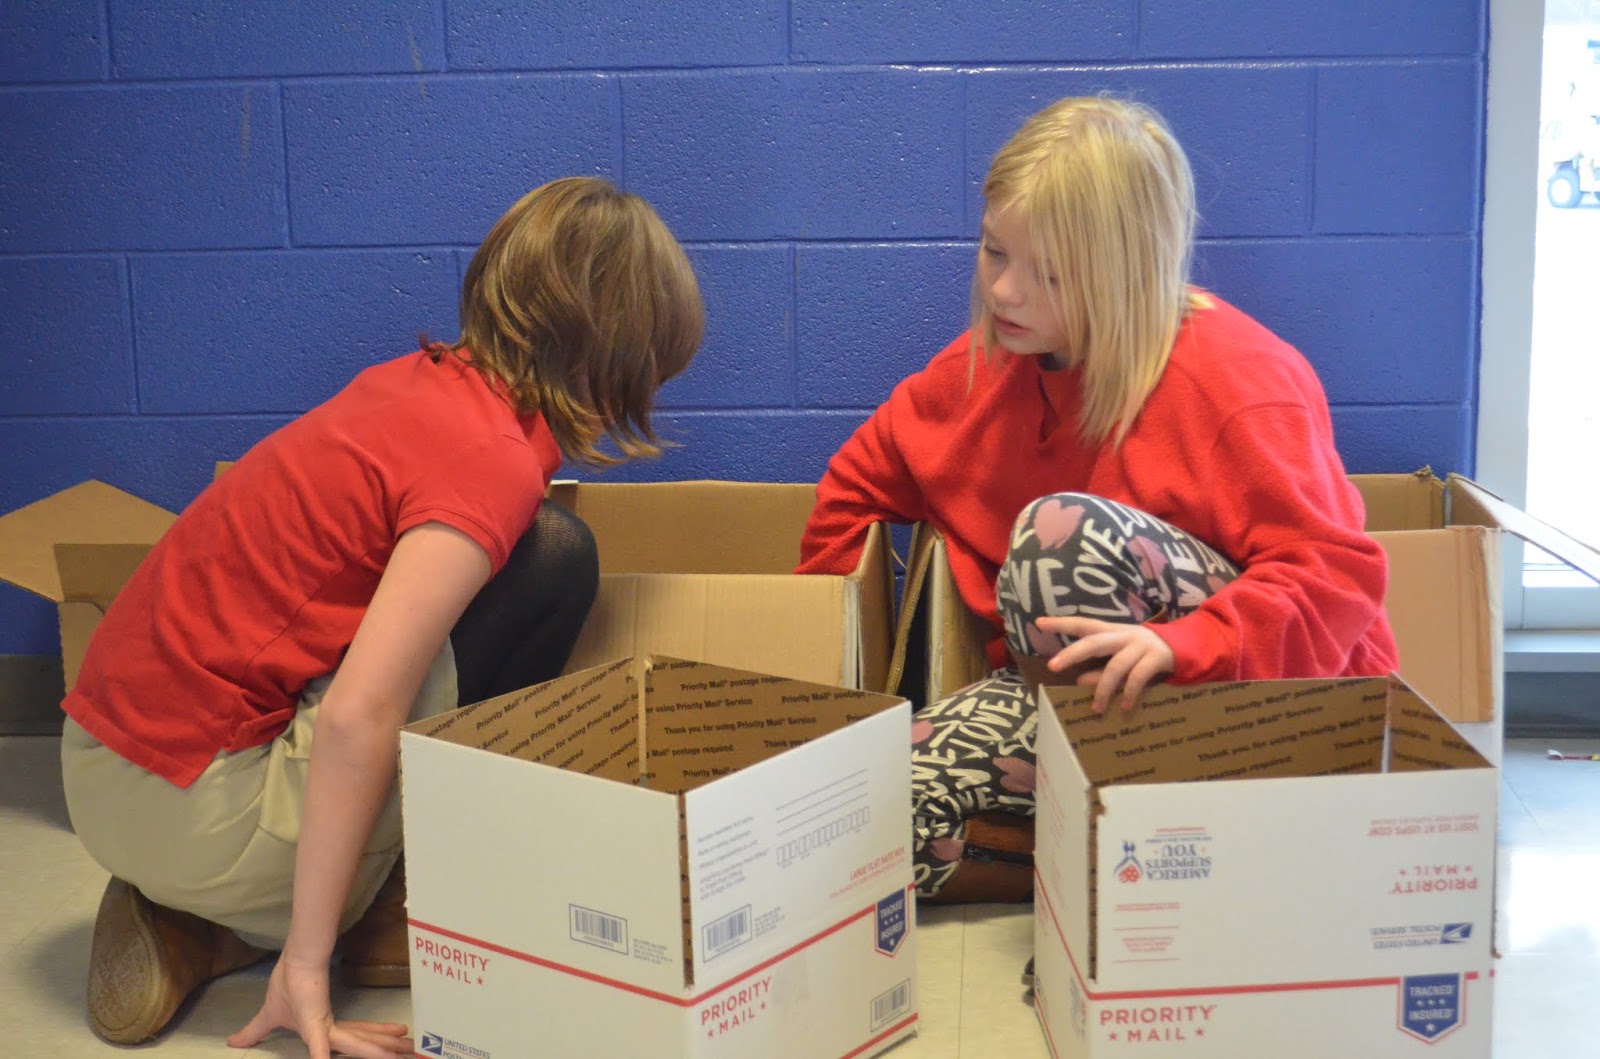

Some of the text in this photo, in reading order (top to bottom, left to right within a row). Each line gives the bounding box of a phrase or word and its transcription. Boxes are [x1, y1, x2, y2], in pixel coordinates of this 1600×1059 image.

[1073, 517, 1132, 617] LOVE
[680, 682, 708, 692] Priority
[534, 700, 560, 718] Priority
[676, 701, 703, 711] Priority
[725, 698, 753, 706] Service
[476, 710, 503, 730] Priority
[530, 722, 556, 741] Priority
[576, 694, 601, 712] Service
[586, 711, 611, 730] Priority
[664, 726, 686, 735] Thank
[688, 725, 701, 734] you
[715, 722, 736, 731] using
[737, 720, 765, 730] Priority
[787, 716, 817, 725] Service
[1216, 722, 1255, 735] Priority
[1285, 705, 1324, 719] Service
[1299, 725, 1337, 738] Priority
[672, 747, 701, 757] postage
[702, 744, 734, 755] required
[683, 768, 710, 778] Priority
[1162, 844, 1198, 857] YOU
[1145, 856, 1212, 869] SUPPORTS
[1413, 865, 1458, 876] MAIL
[1145, 867, 1211, 880] AMERICA
[1391, 878, 1478, 894] PRIORITY
[415, 936, 489, 972] PRIORITY
[433, 960, 472, 985] MAIL
[1408, 984, 1456, 997] TRACKED
[700, 976, 772, 1026] PRIORITY
[718, 1007, 756, 1035] MAIL
[1099, 1004, 1218, 1026] PRIORITY
[1408, 1008, 1455, 1020] INSURED
[1126, 1027, 1187, 1042] MAIL
[443, 1037, 491, 1059] UNITED STATES
